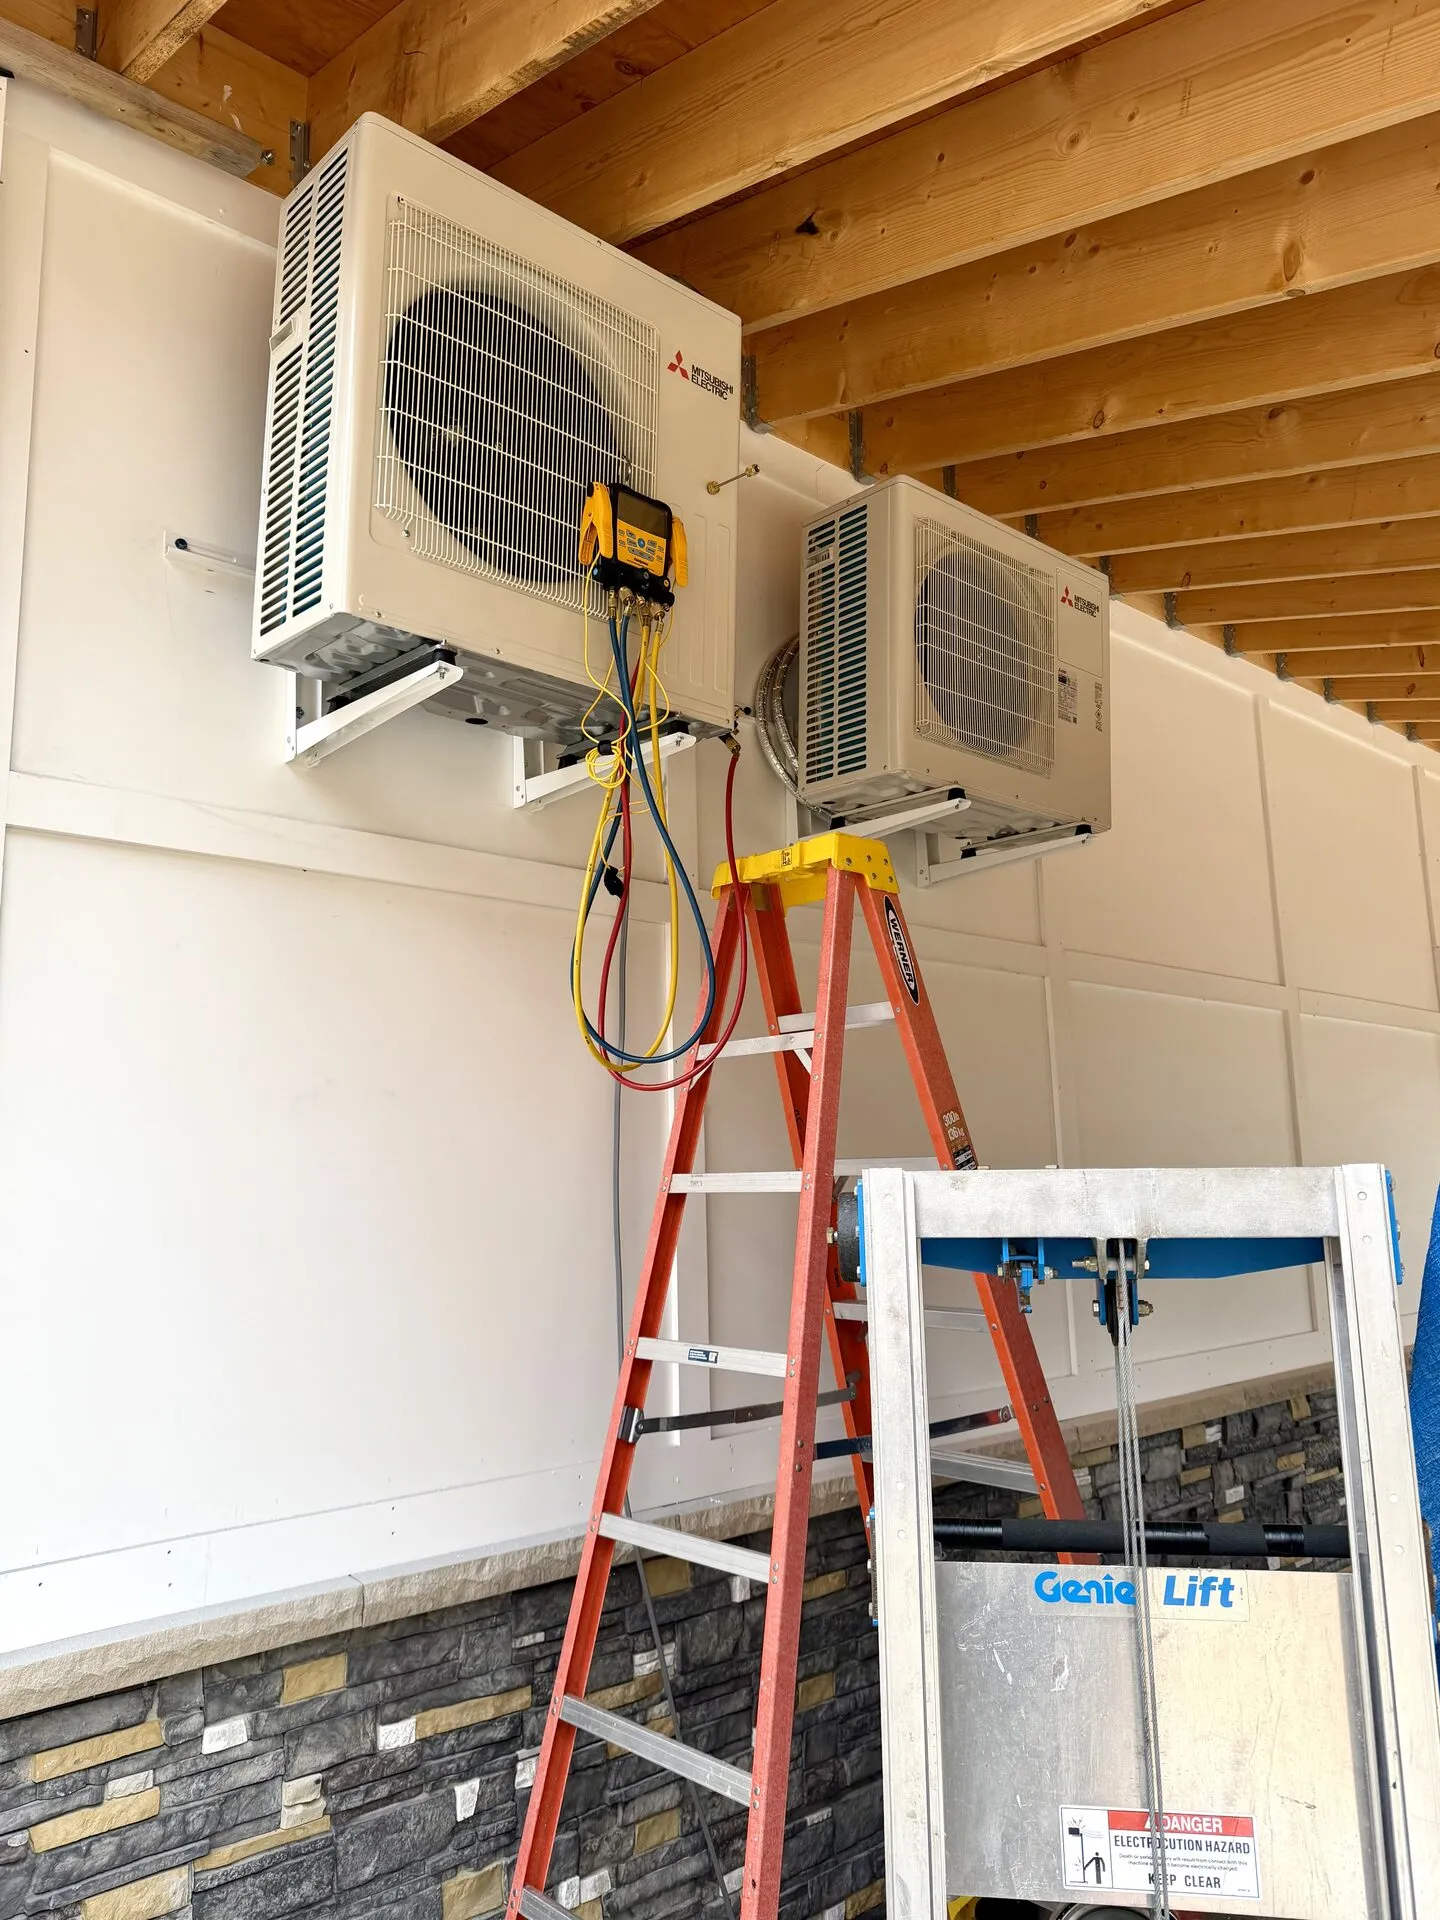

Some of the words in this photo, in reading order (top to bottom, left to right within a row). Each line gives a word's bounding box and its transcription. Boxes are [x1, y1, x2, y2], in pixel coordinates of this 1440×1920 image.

[691, 364, 734, 395] MITSUBISHI
[691, 373, 728, 401] ELECTRIC
[1074, 594, 1100, 613] MITSUBISHI
[1074, 601, 1097, 618] ELECTRIC
[889, 917, 914, 983] WERNER
[1034, 1570, 1137, 1605] Genie
[1163, 1575, 1235, 1608] Lift
[1162, 1816, 1223, 1833] DANGER
[1205, 1840, 1250, 1854] HAZARD
[1184, 1875, 1221, 1889] CLEAR
